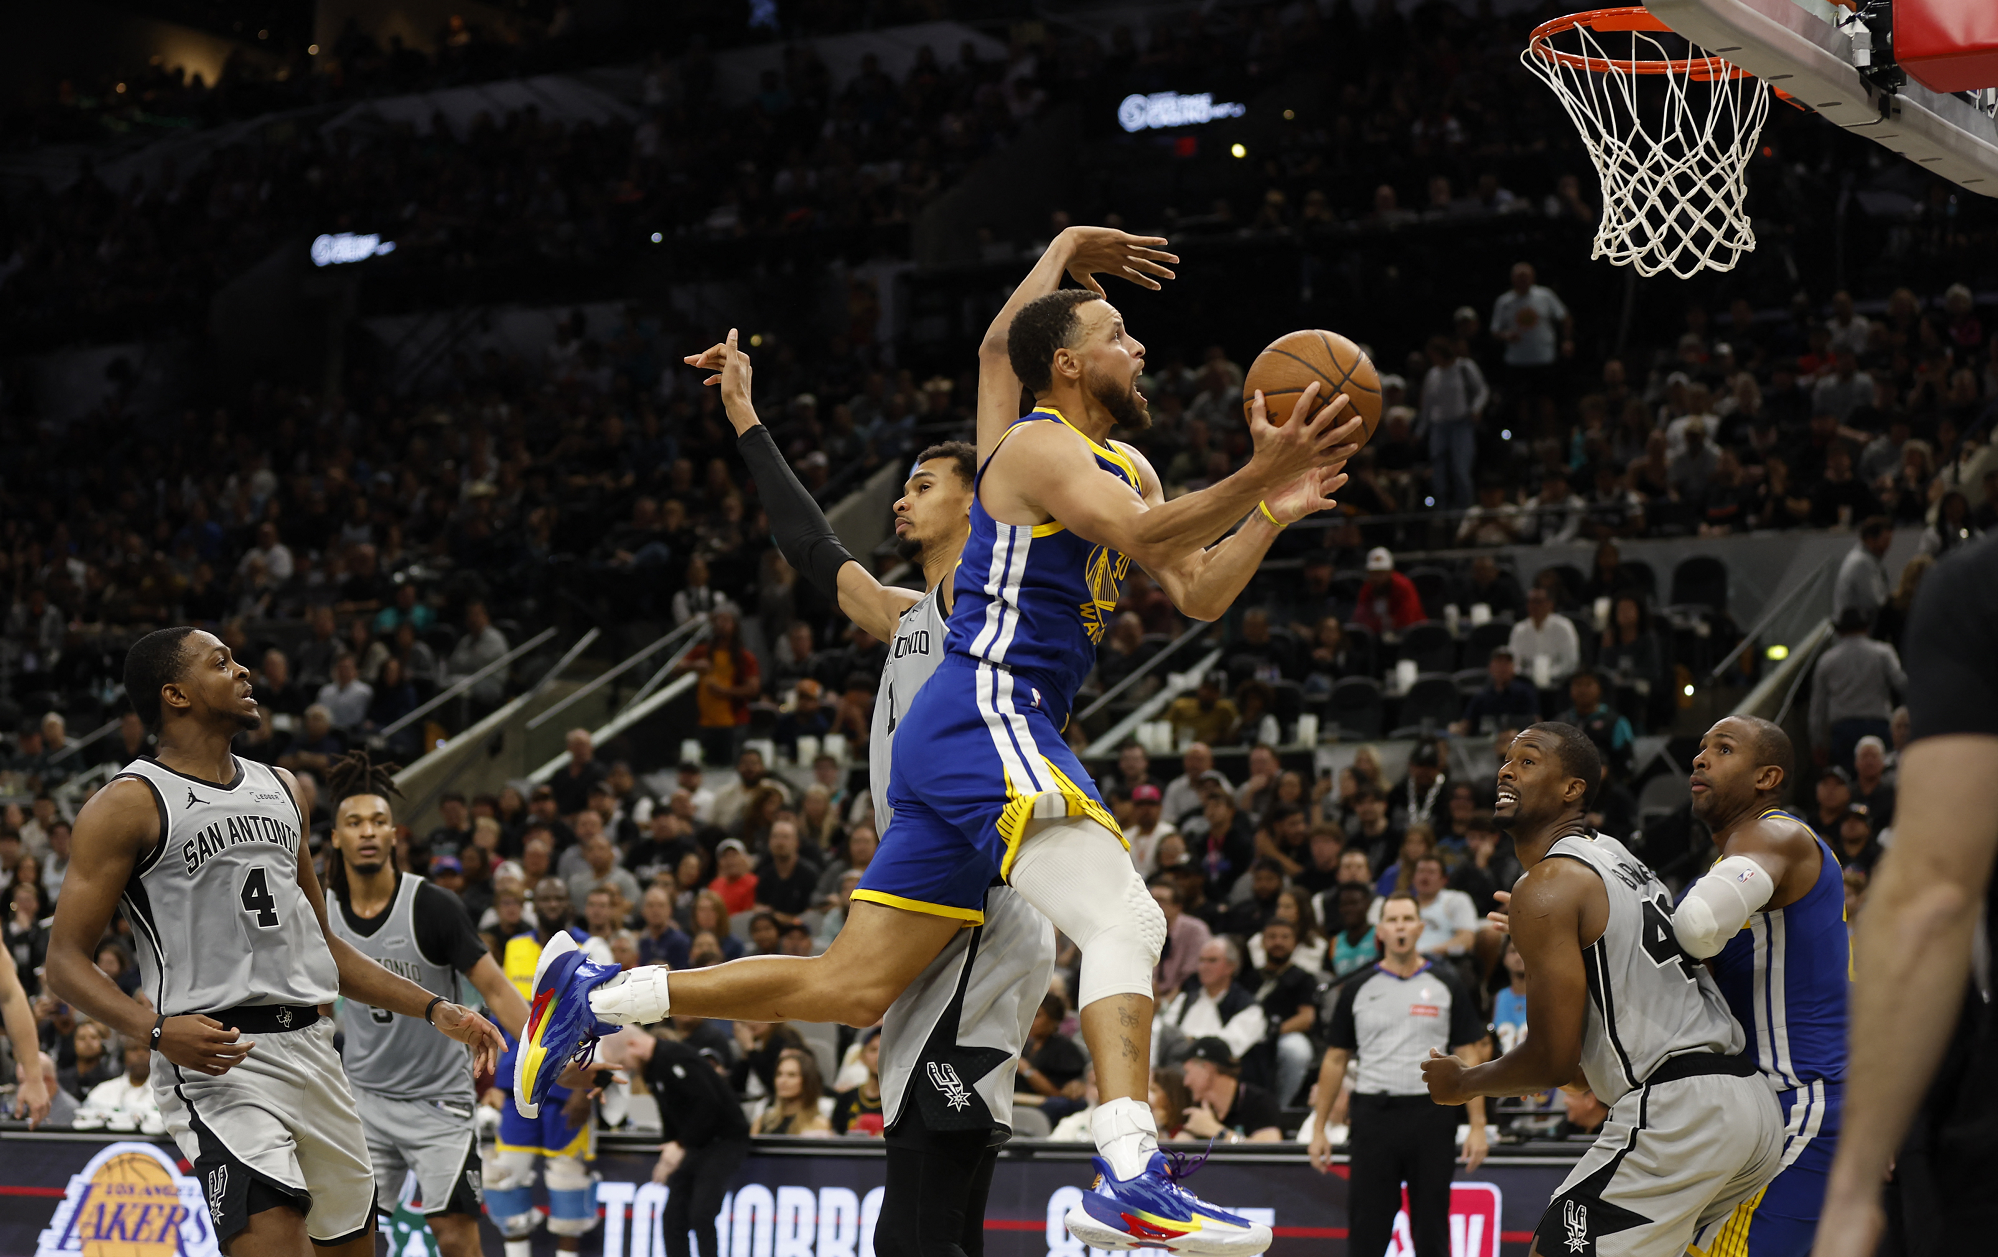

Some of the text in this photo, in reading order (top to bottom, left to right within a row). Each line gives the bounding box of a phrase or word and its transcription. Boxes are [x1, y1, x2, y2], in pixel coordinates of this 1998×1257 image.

[1114, 551, 1131, 581] 30
[182, 815, 299, 876] SAN ANTONIO
[240, 865, 281, 929] 4
[1639, 891, 1704, 984] 4
[57, 1182, 208, 1257] LAKERS
[106, 1183, 204, 1198] LOS ANGEL
